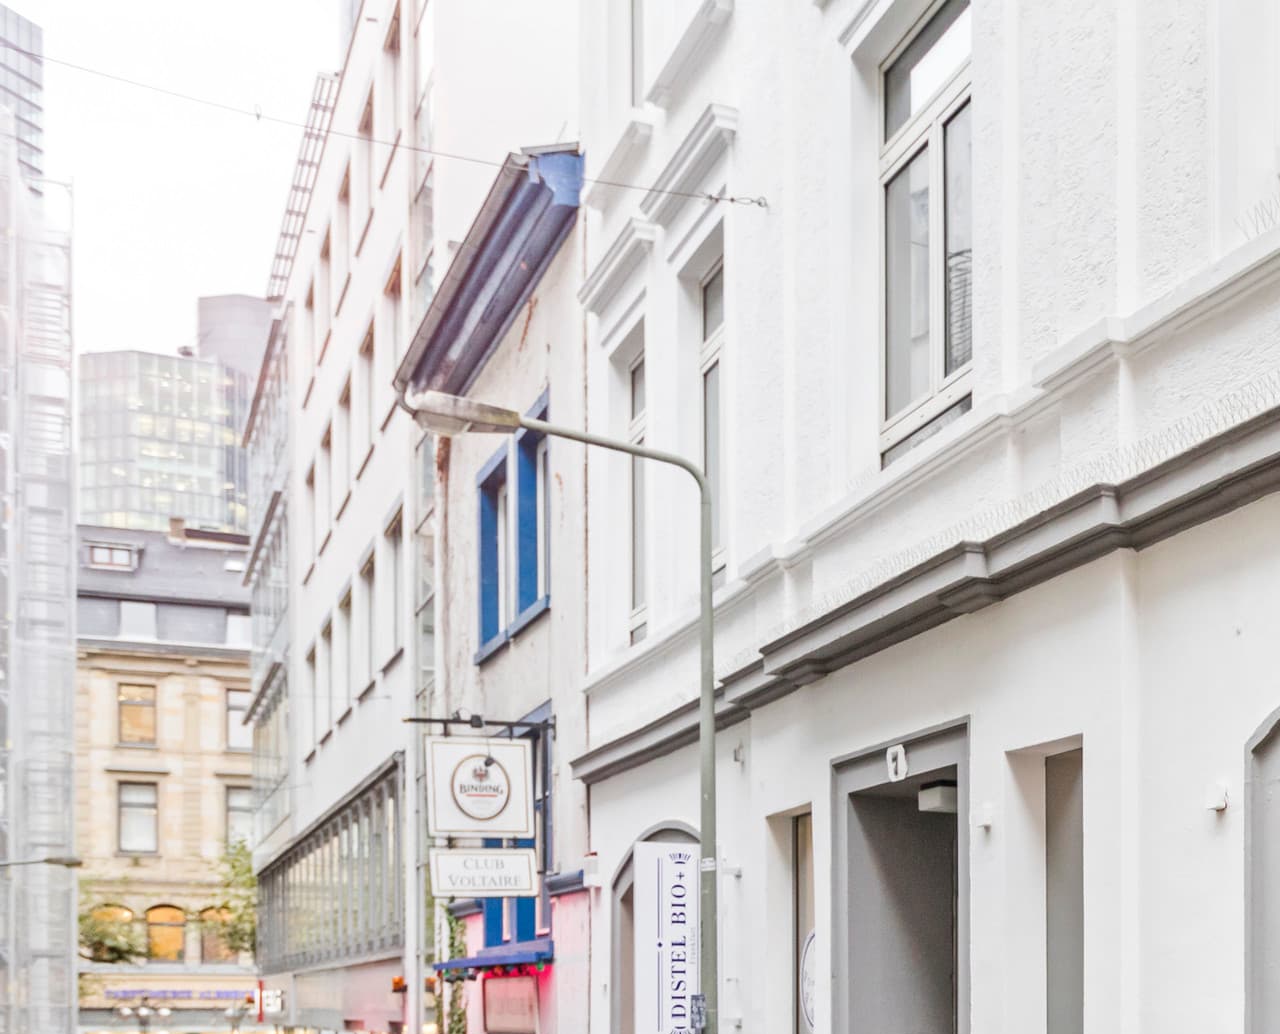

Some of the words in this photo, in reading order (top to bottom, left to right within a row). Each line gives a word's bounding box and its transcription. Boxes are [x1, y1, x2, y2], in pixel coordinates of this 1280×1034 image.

[459, 783, 504, 795] BINDING
[463, 858, 505, 871] CLUB
[448, 874, 521, 888] VOLTAIRE
[670, 935, 687, 1019] DISTEL
